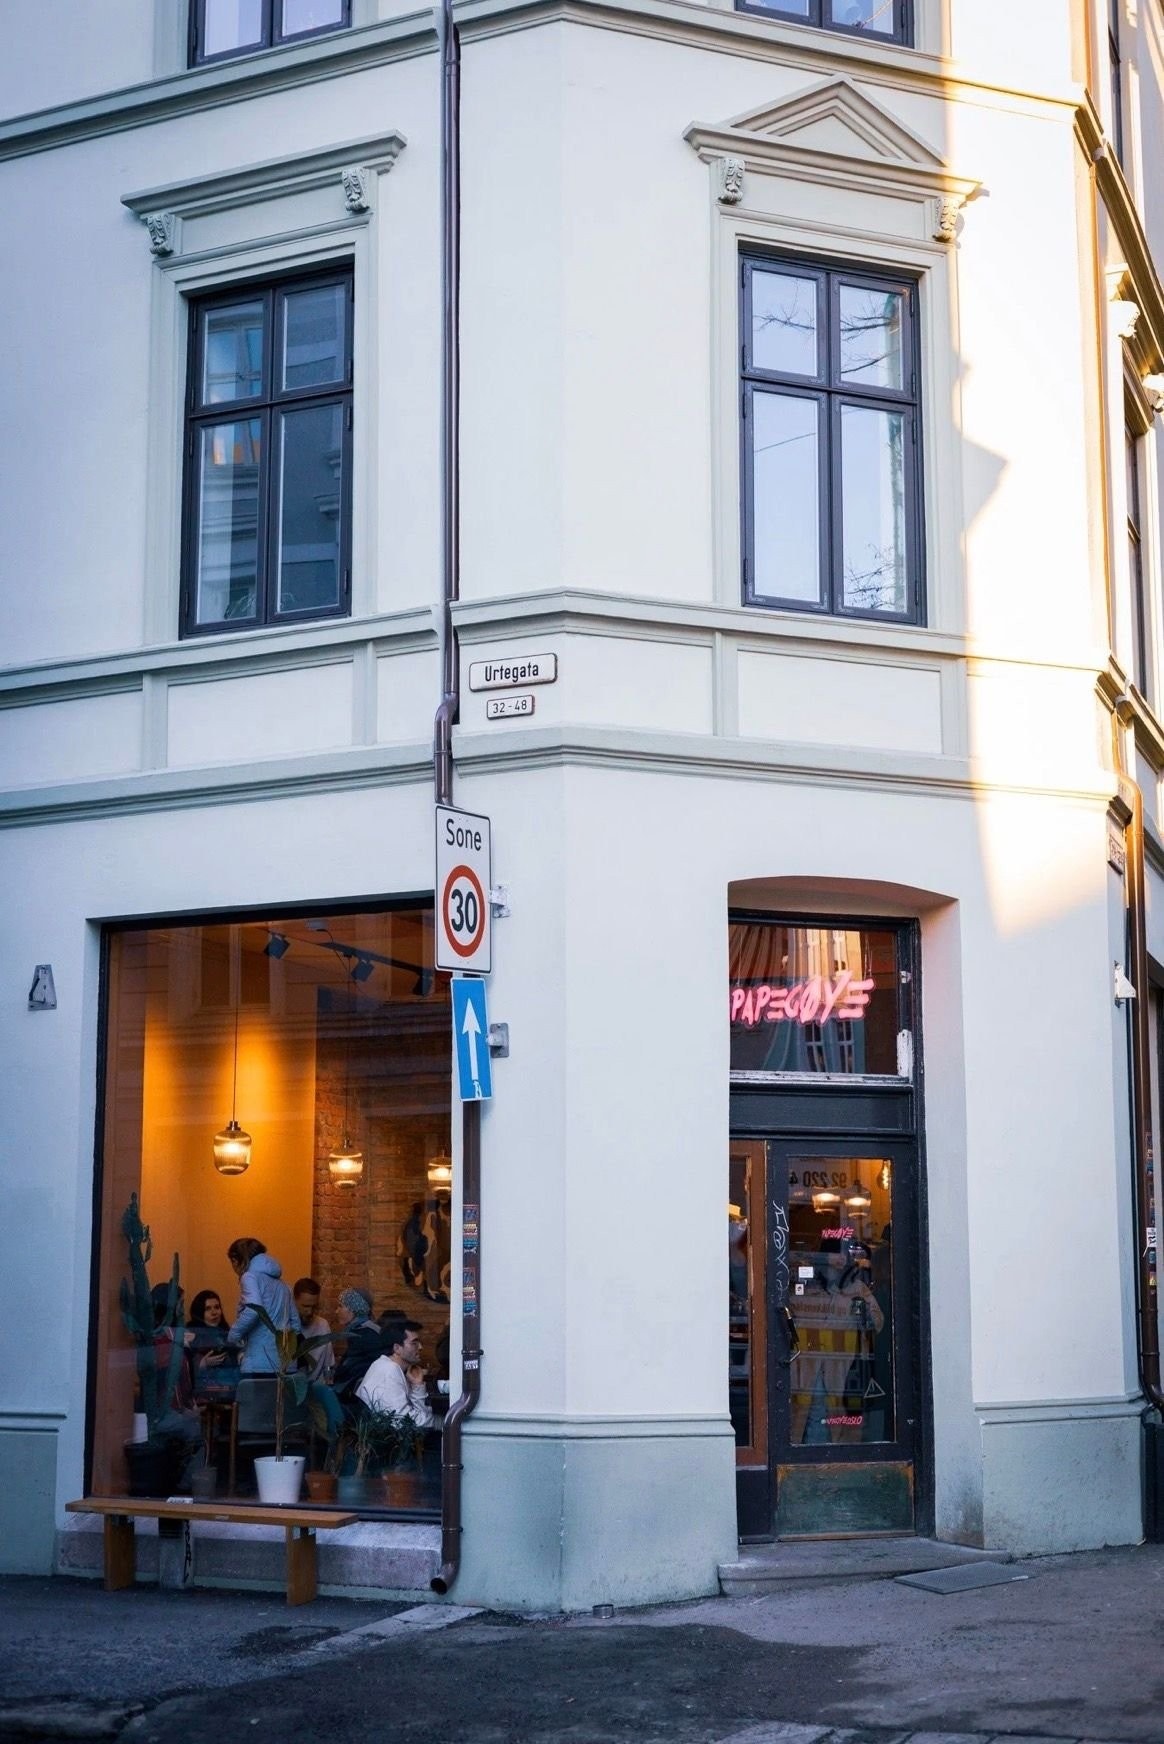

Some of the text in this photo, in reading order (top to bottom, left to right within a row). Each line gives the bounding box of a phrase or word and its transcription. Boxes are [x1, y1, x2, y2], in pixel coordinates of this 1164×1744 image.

[484, 661, 539, 683] Urtegata
[445, 817, 482, 852] Sone
[450, 887, 478, 934] 30
